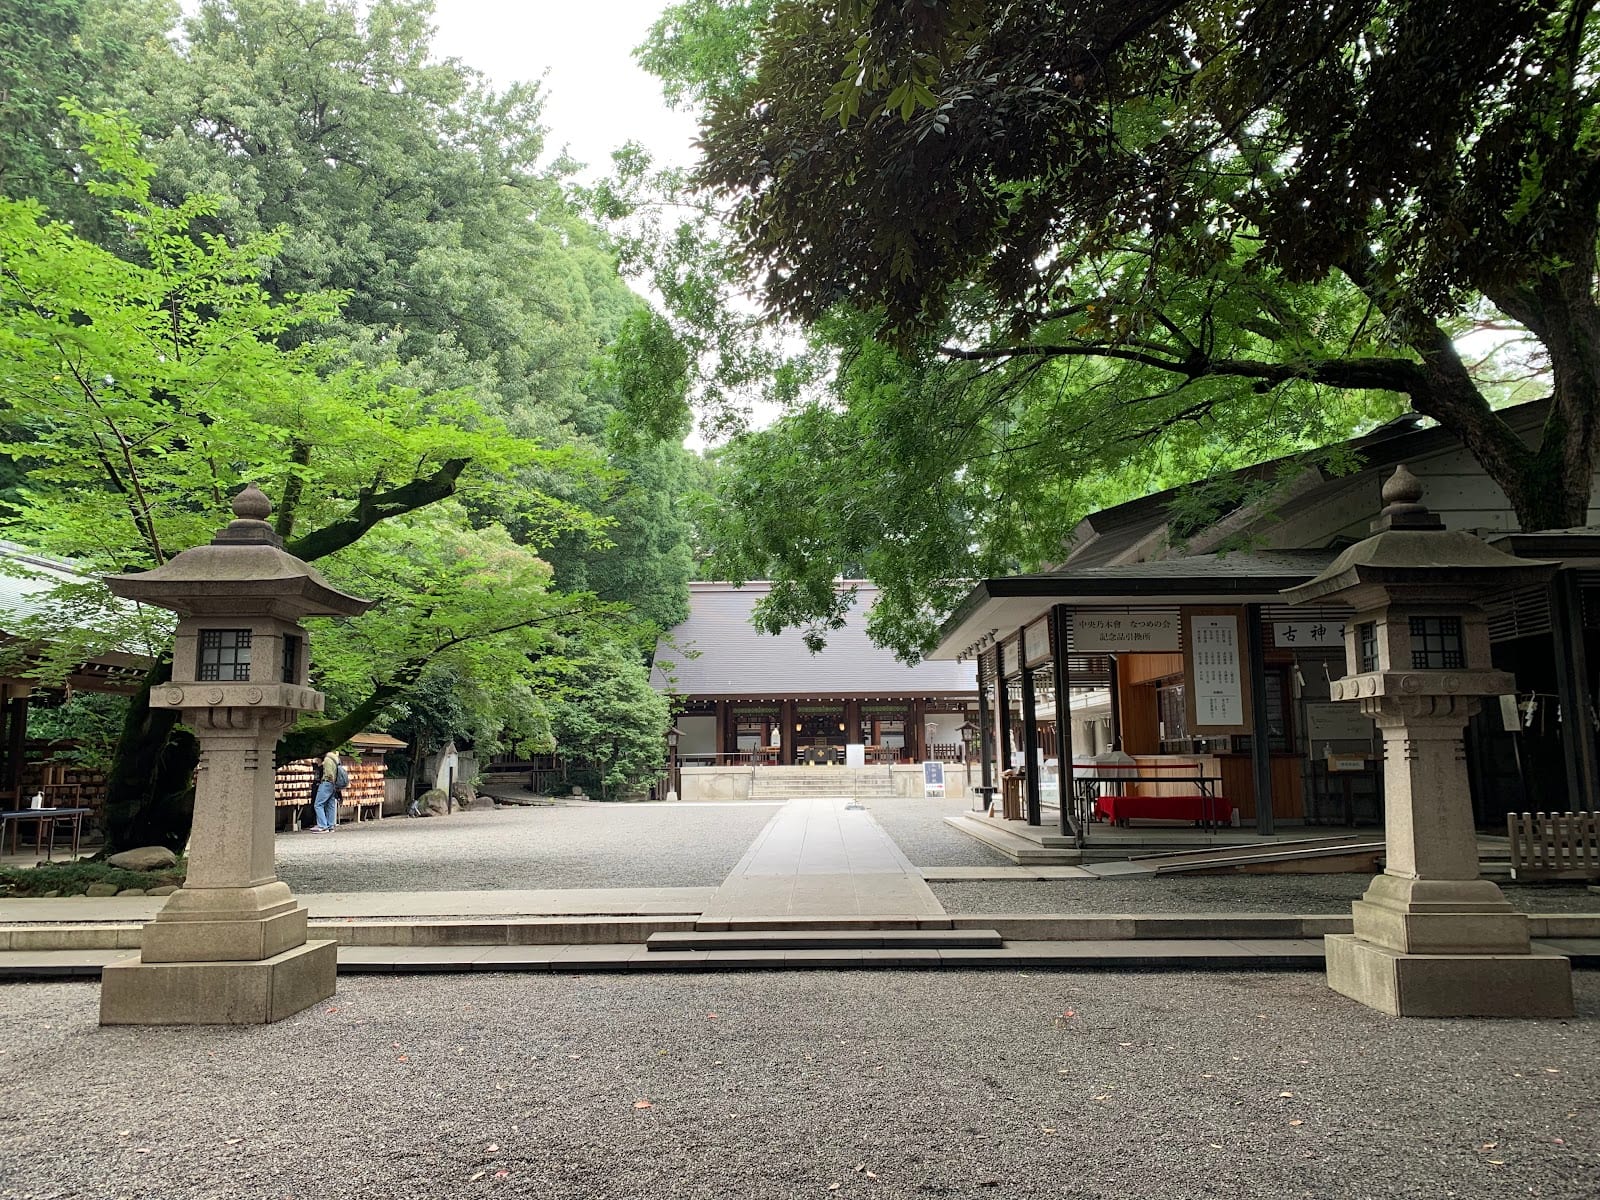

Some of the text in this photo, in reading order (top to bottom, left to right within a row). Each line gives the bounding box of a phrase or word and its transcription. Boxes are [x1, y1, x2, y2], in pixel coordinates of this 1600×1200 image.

[1130, 619, 1171, 629] なつめの会
